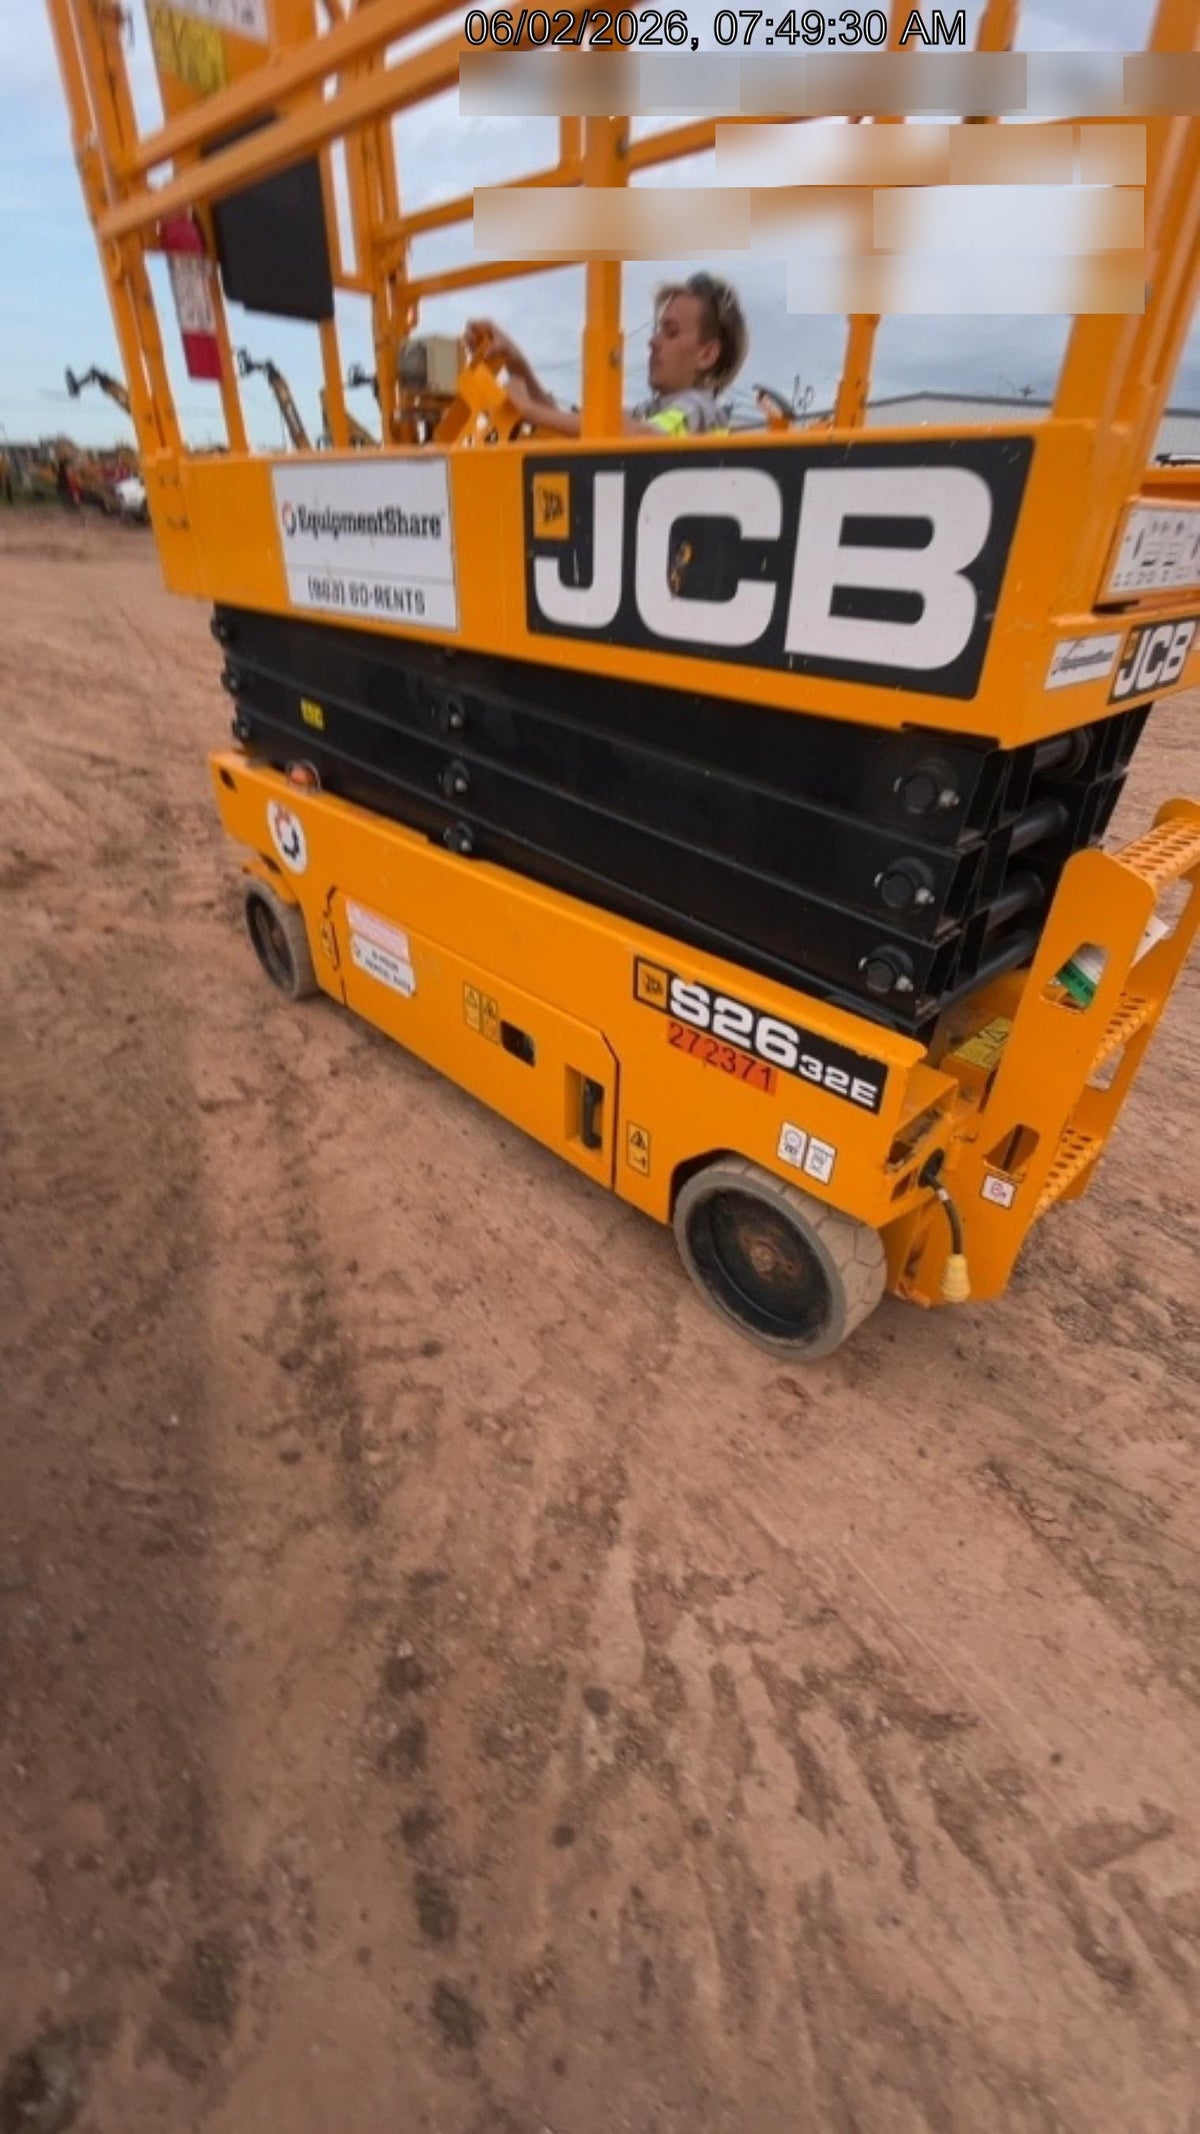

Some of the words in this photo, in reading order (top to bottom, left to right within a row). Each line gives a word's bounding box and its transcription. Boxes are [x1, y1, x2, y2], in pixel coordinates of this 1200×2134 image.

[297, 504, 442, 542] EquipmentShare
[533, 465, 993, 670] JCB
[1112, 621, 1197, 698] JCB
[668, 1021, 773, 1093] 272371
